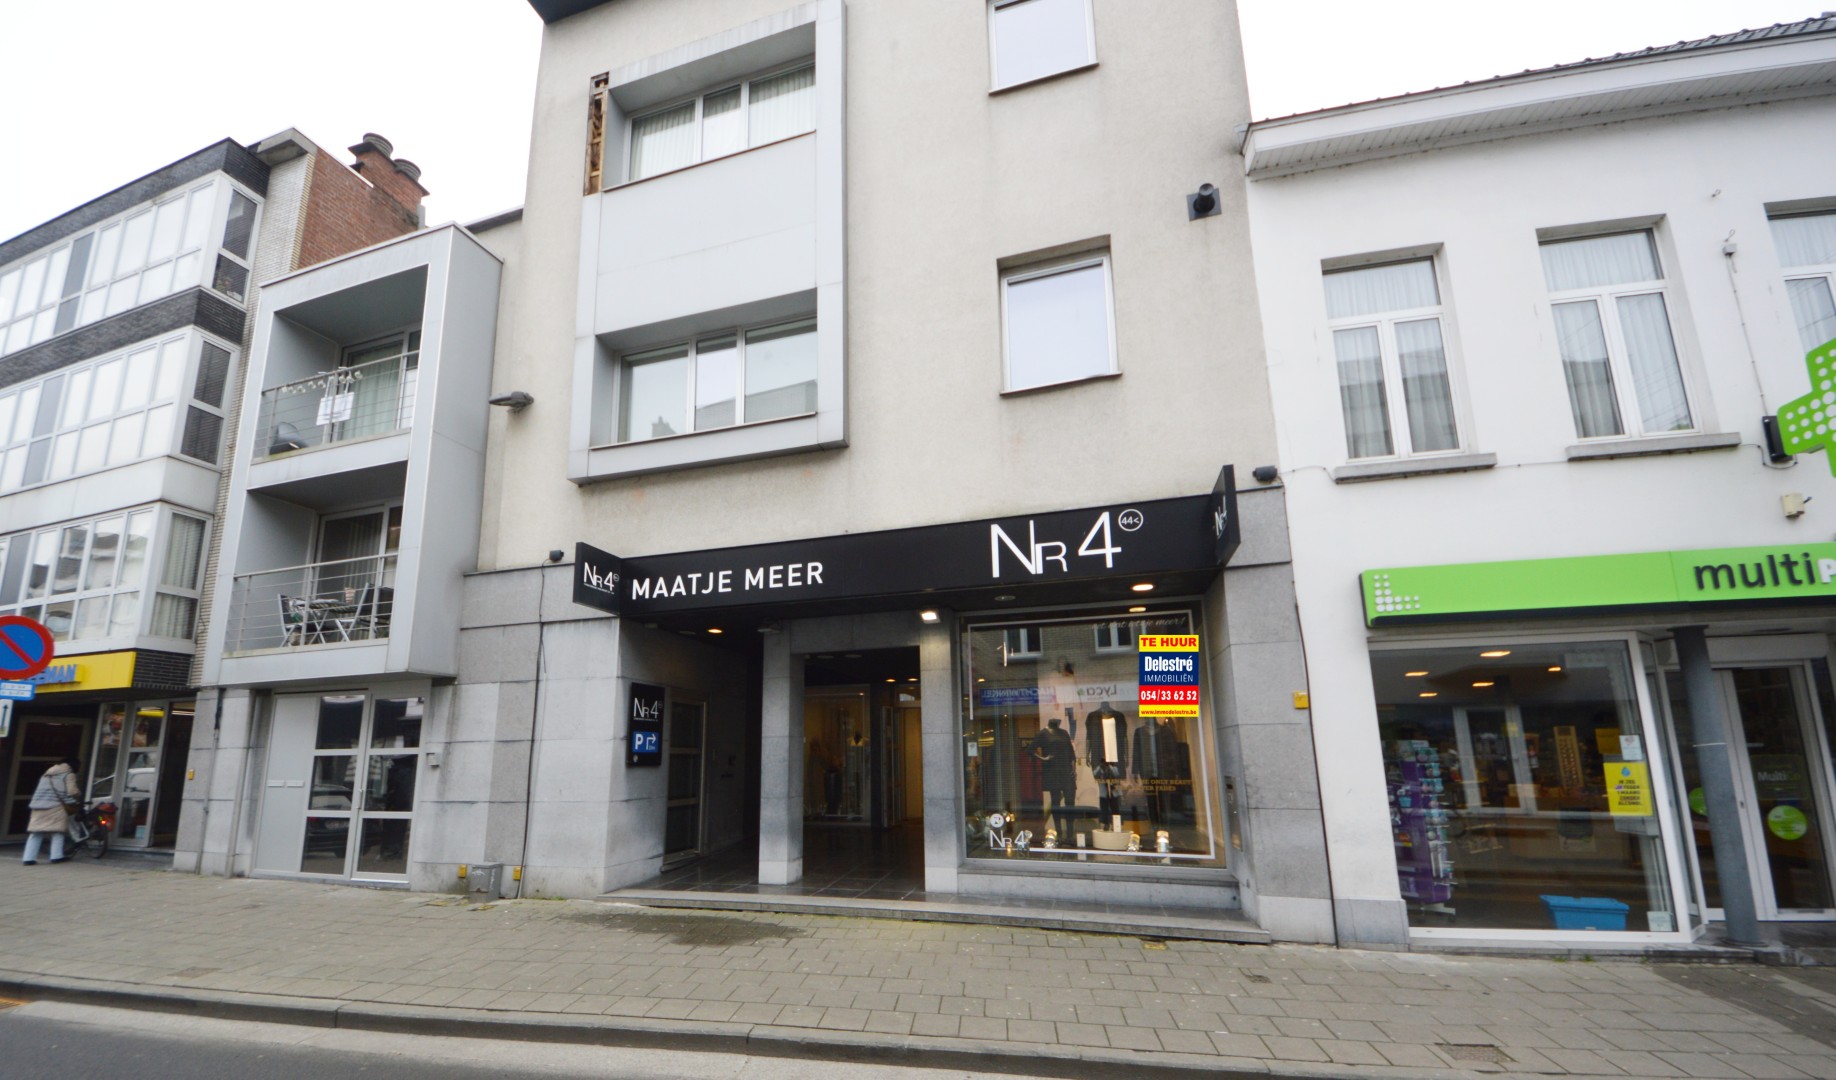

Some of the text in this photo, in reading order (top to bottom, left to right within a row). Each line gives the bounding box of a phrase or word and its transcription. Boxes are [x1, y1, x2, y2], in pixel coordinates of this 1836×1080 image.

[1078, 511, 1122, 568] 4
[631, 561, 824, 600] MAATJE MEER
[635, 733, 644, 750] P
